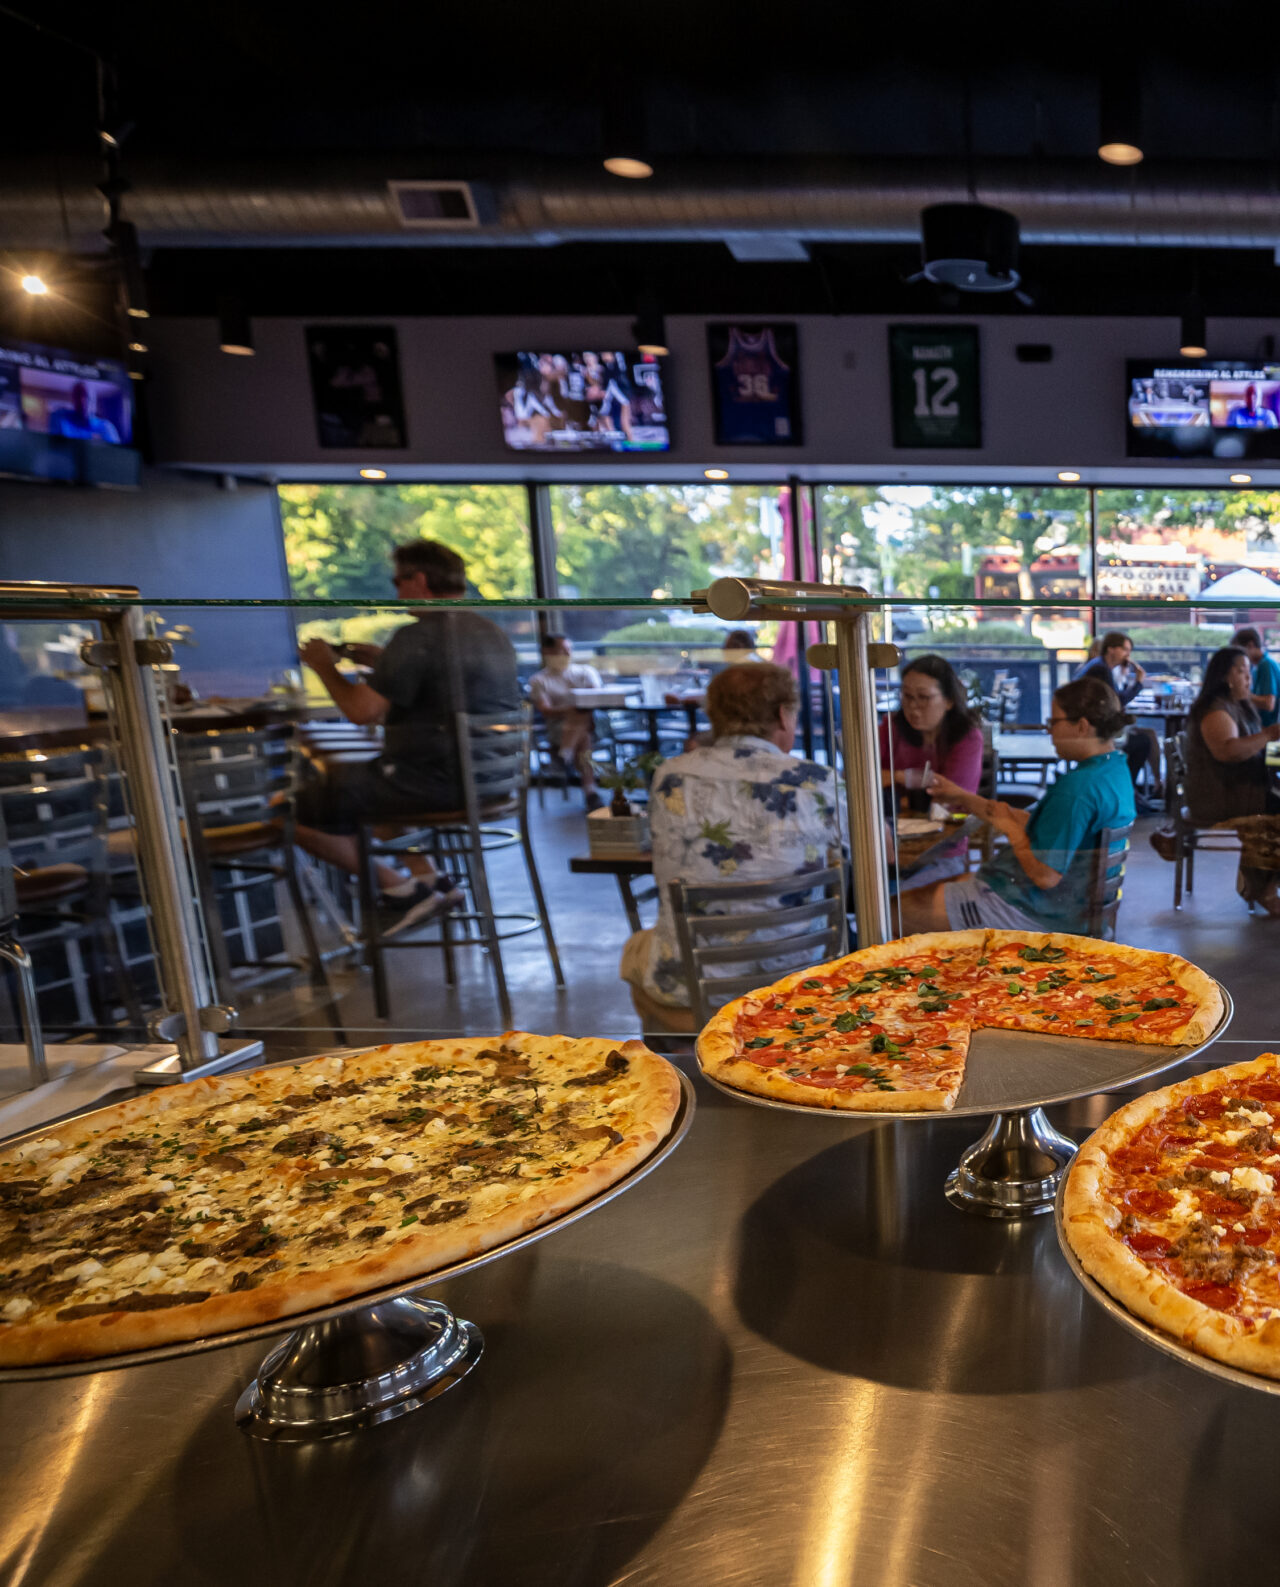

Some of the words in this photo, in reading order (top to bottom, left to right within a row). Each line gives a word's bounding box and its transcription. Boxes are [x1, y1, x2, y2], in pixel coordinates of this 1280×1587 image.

[736, 374, 770, 396] 36
[912, 367, 959, 416] 12
[1138, 568, 1191, 581] COFFEE
[1159, 583, 1185, 593] BAR
